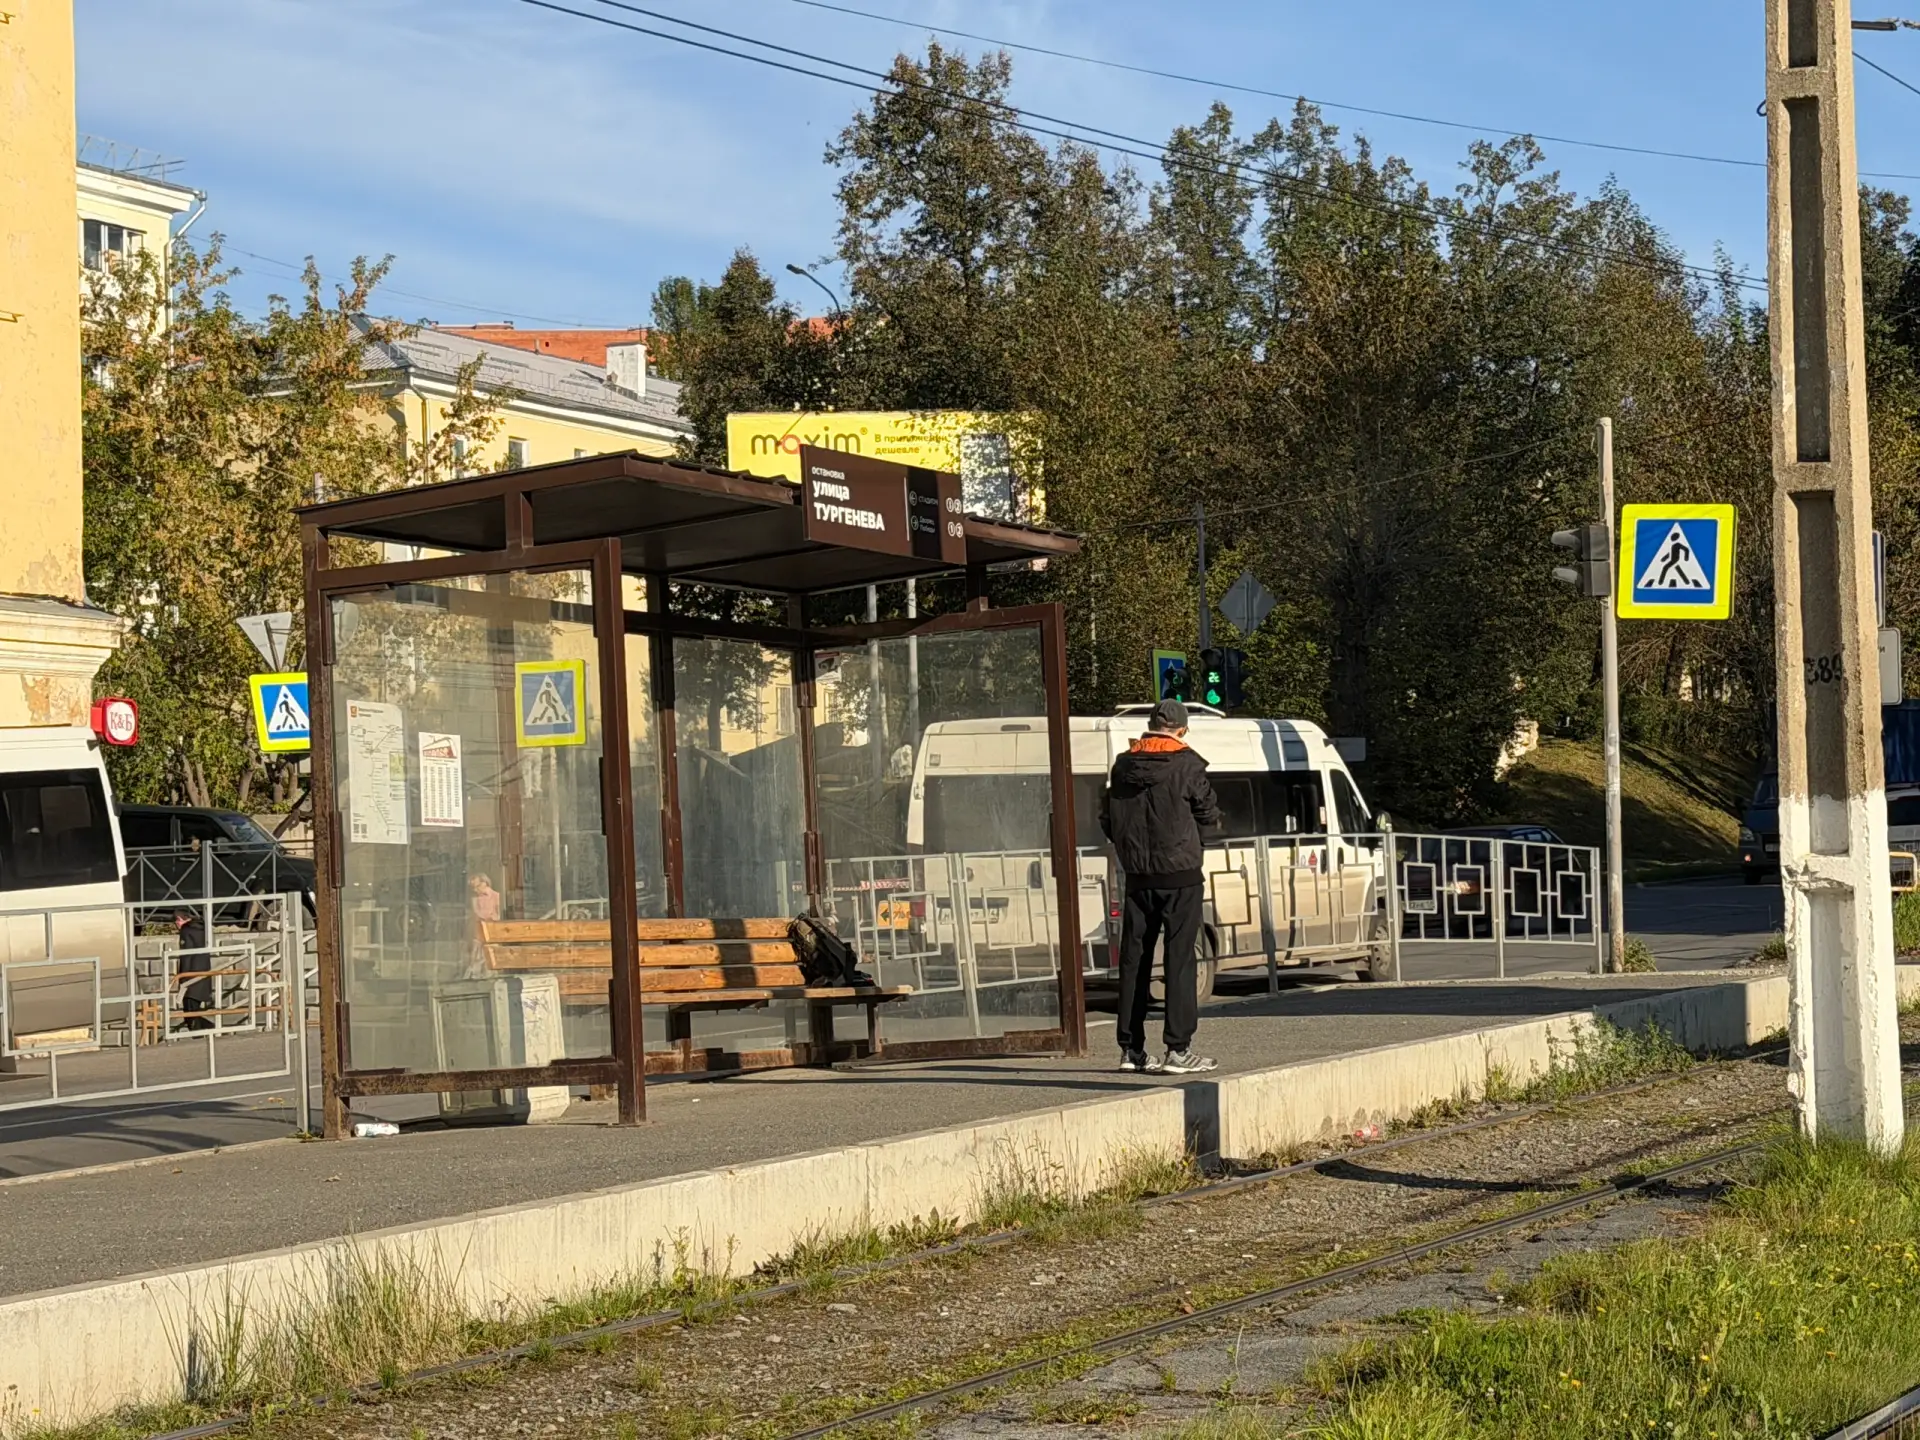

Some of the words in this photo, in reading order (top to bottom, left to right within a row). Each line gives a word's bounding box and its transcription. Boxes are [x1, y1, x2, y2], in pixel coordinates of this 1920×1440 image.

[751, 426, 861, 455] maxim
[874, 434, 882, 443] В
[874, 446, 920, 455] дешевле
[812, 480, 850, 501] улица
[813, 501, 886, 531] ТУРГЕНЕВА
